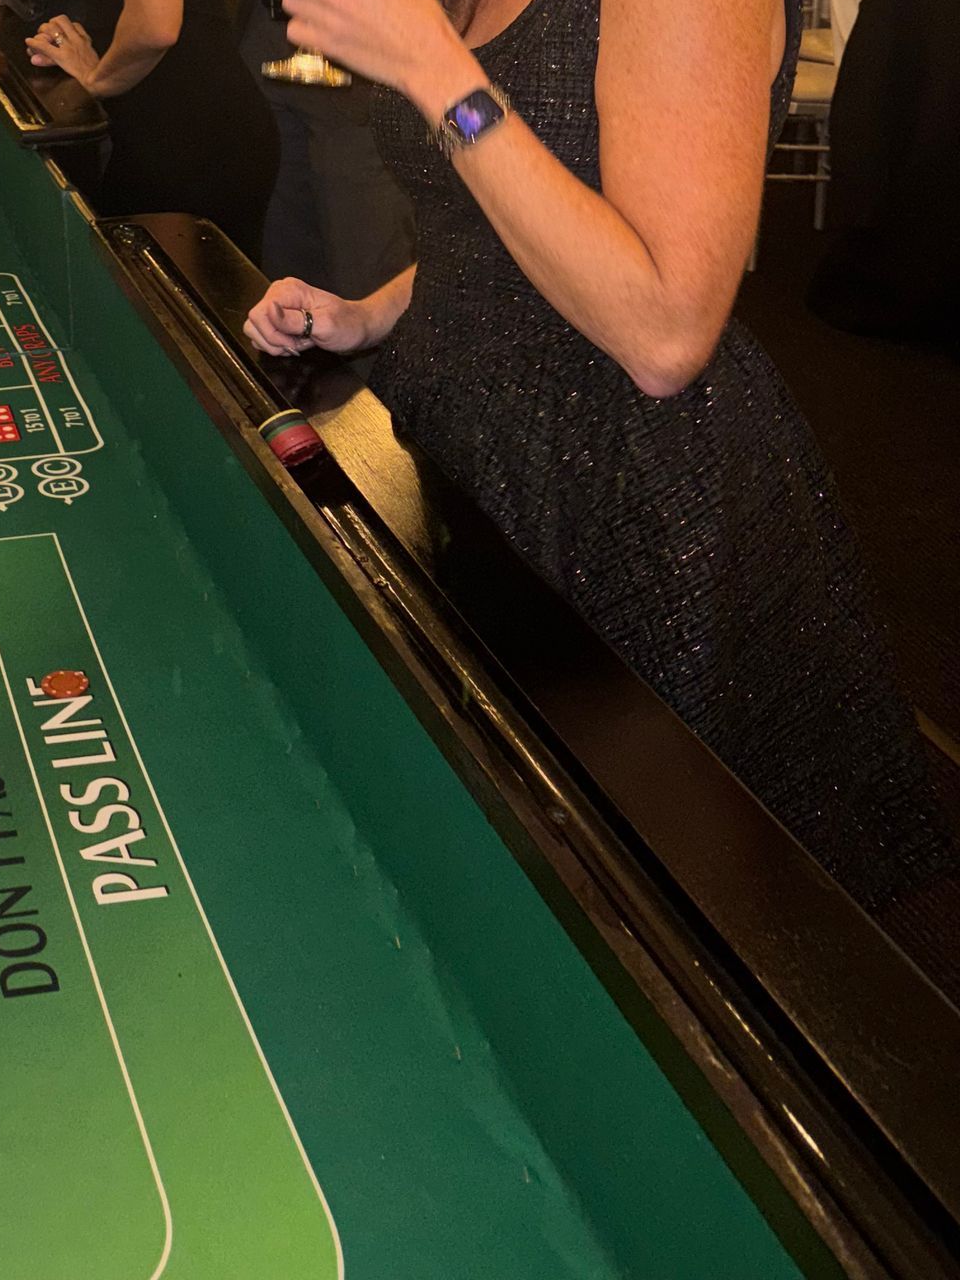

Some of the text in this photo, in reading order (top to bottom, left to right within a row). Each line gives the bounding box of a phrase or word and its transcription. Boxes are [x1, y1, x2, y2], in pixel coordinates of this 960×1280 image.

[13, 323, 52, 359] CRAPS
[32, 359, 64, 383] ANY
[59, 776, 169, 905] PASS
